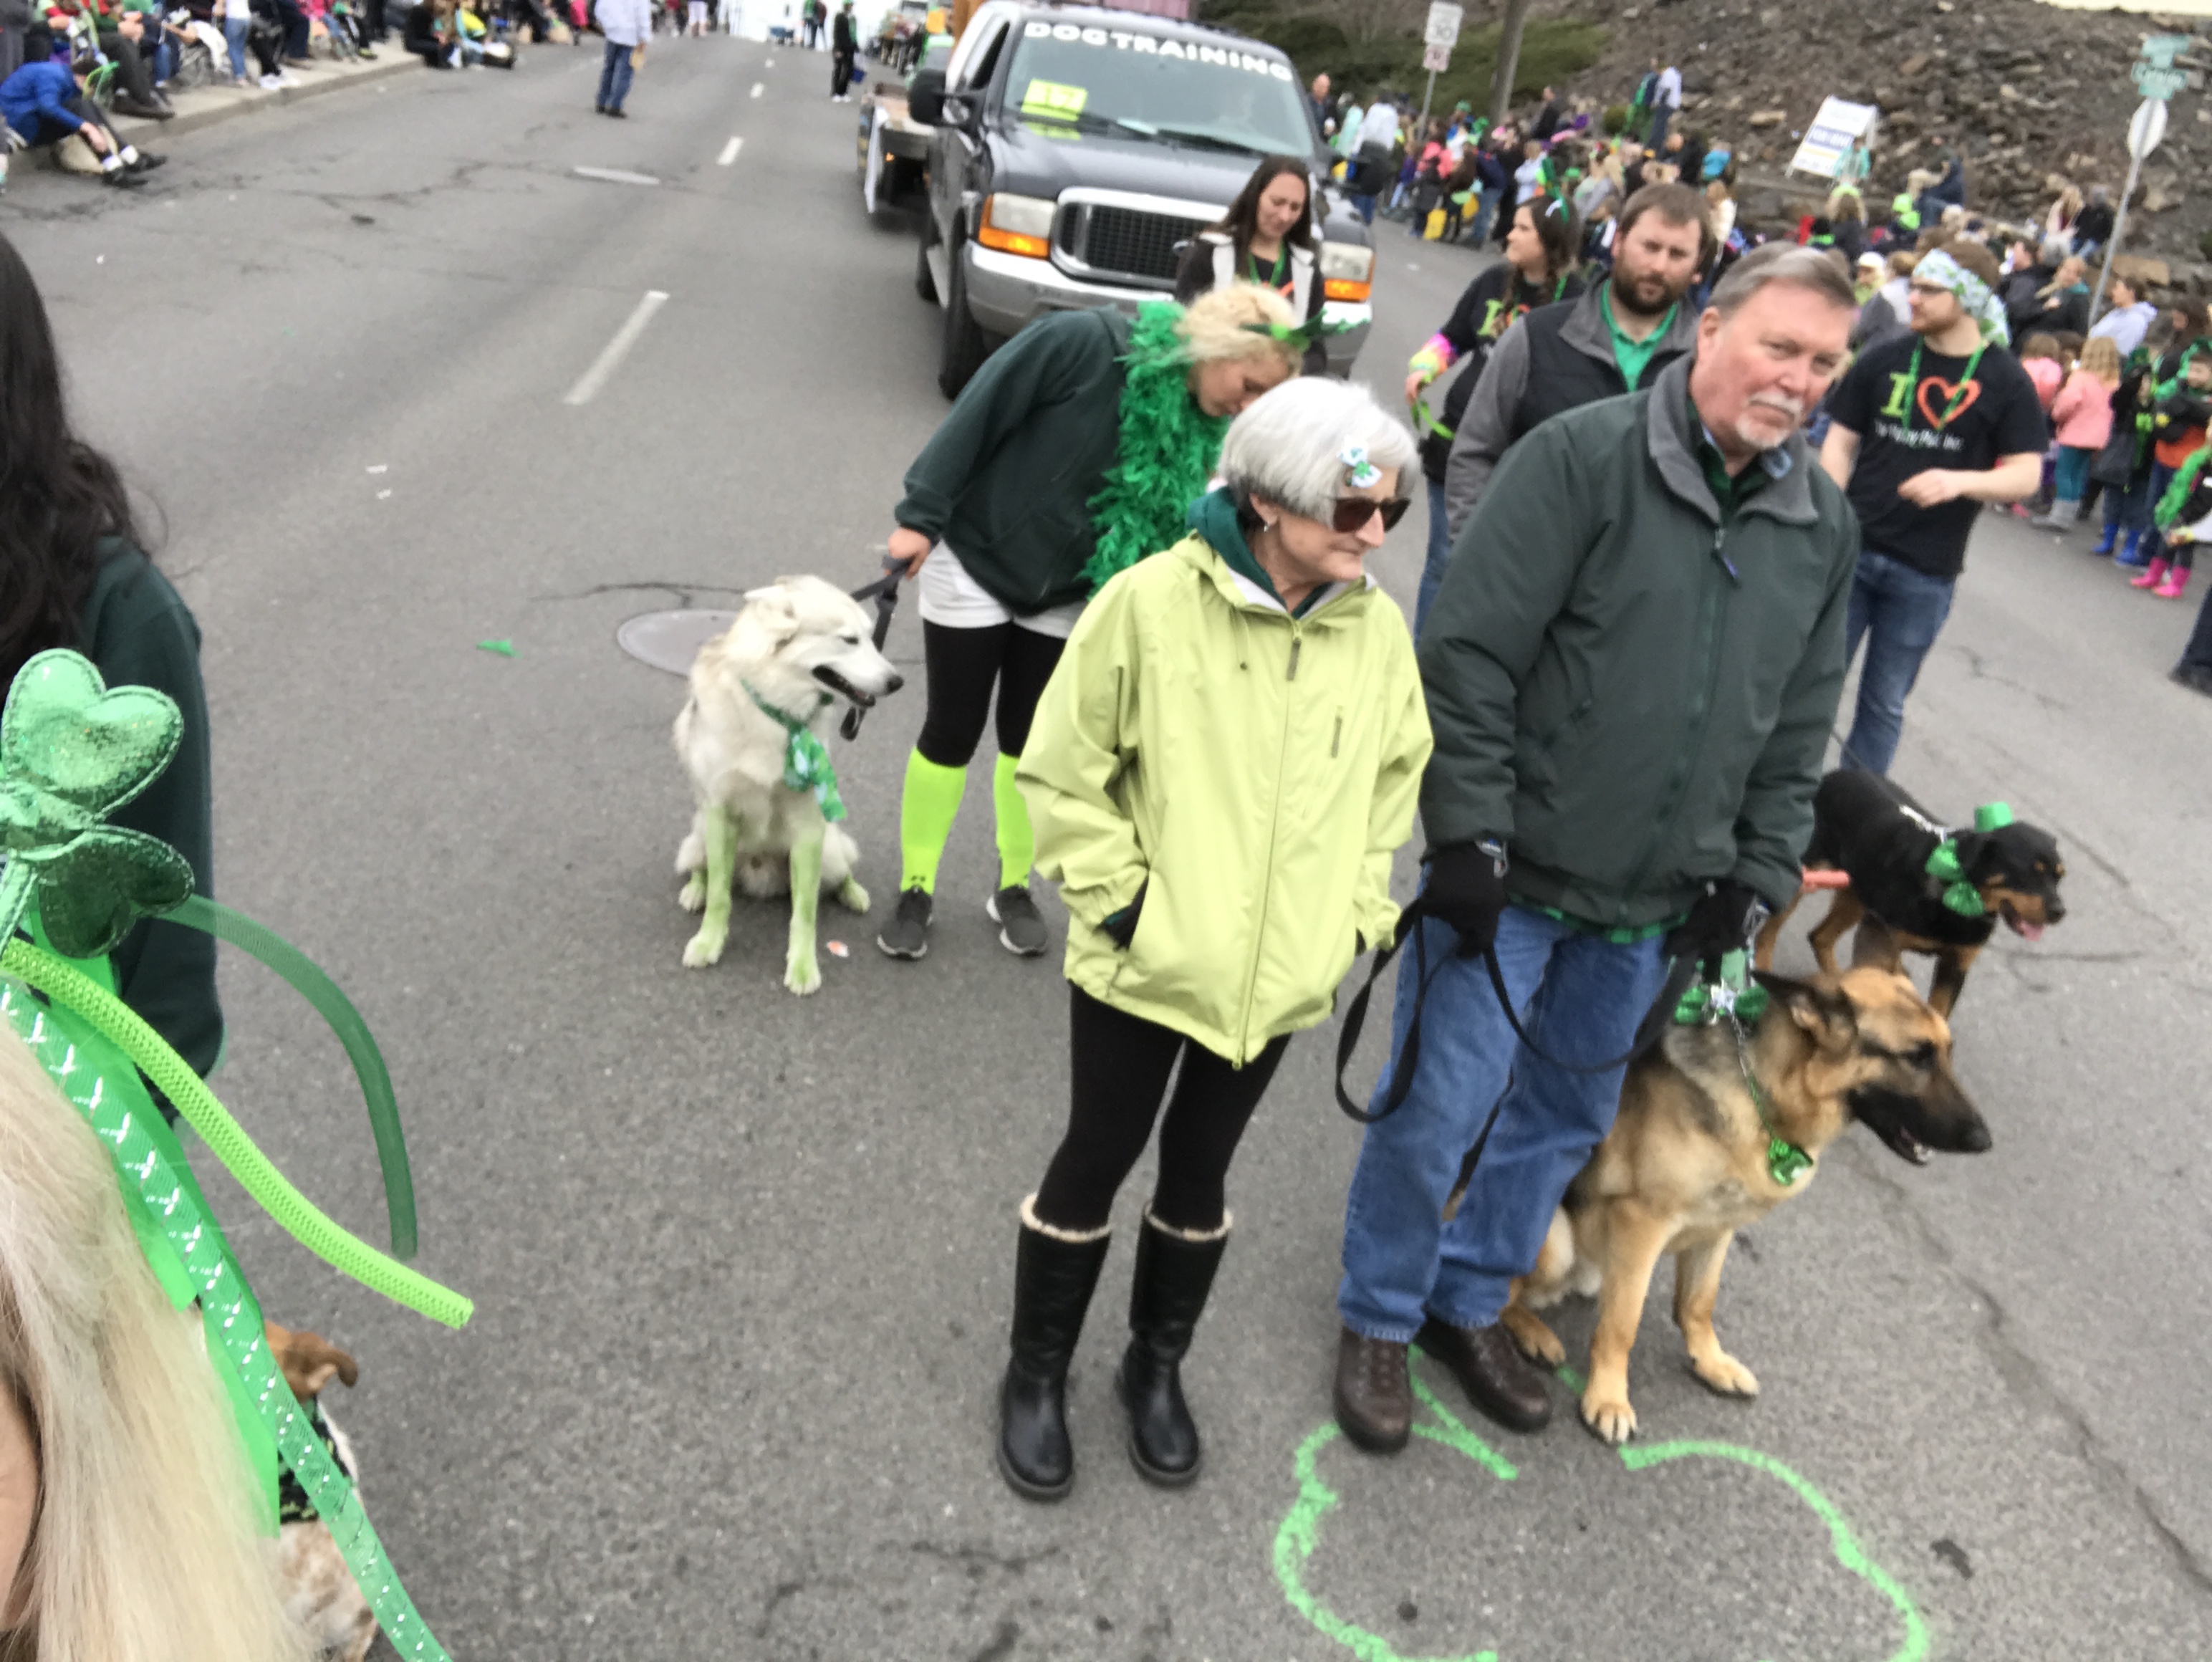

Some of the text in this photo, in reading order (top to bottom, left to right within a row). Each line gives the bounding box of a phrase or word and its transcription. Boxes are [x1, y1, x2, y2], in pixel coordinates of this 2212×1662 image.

[1024, 21, 1294, 82] DOG TRAINING
[1880, 372, 1915, 416] I
